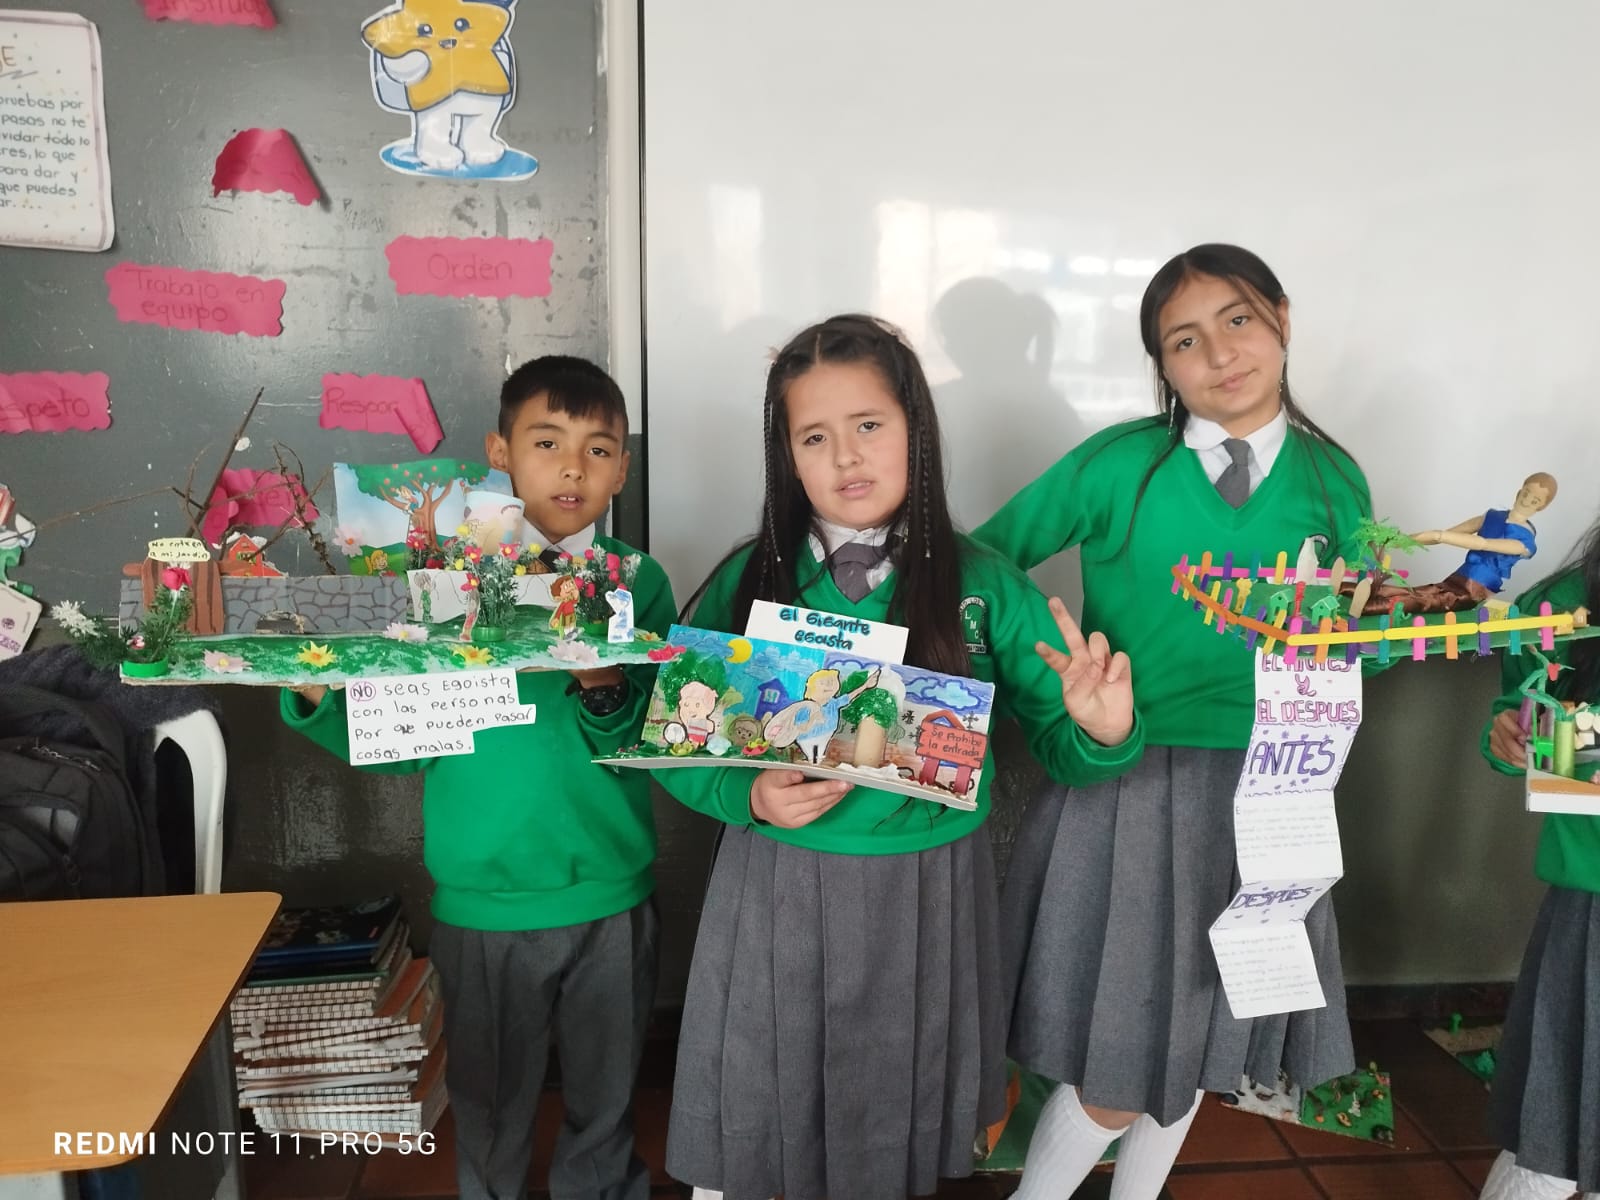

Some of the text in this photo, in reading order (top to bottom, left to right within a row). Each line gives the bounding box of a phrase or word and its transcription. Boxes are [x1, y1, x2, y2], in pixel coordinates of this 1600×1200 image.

[60, 99, 84, 112] por
[51, 117, 67, 127] no
[71, 115, 87, 129] te
[43, 131, 76, 146] todo
[79, 135, 90, 146] lo
[34, 147, 48, 159] lo
[52, 150, 77, 163] que
[34, 164, 60, 179] dar
[26, 182, 77, 197] puedes
[427, 252, 513, 281] Orden
[124, 268, 265, 304] Trabajo en
[140, 300, 229, 328] equipo
[779, 607, 798, 621] El
[352, 683, 374, 699] NO
[384, 682, 431, 697] seas
[352, 707, 383, 720] con
[393, 700, 417, 714] las
[1256, 698, 1361, 723] EL DESPUES
[356, 739, 472, 760] cosas malas.
[928, 739, 980, 757] la entrada
[1248, 739, 1336, 776] ANTES
